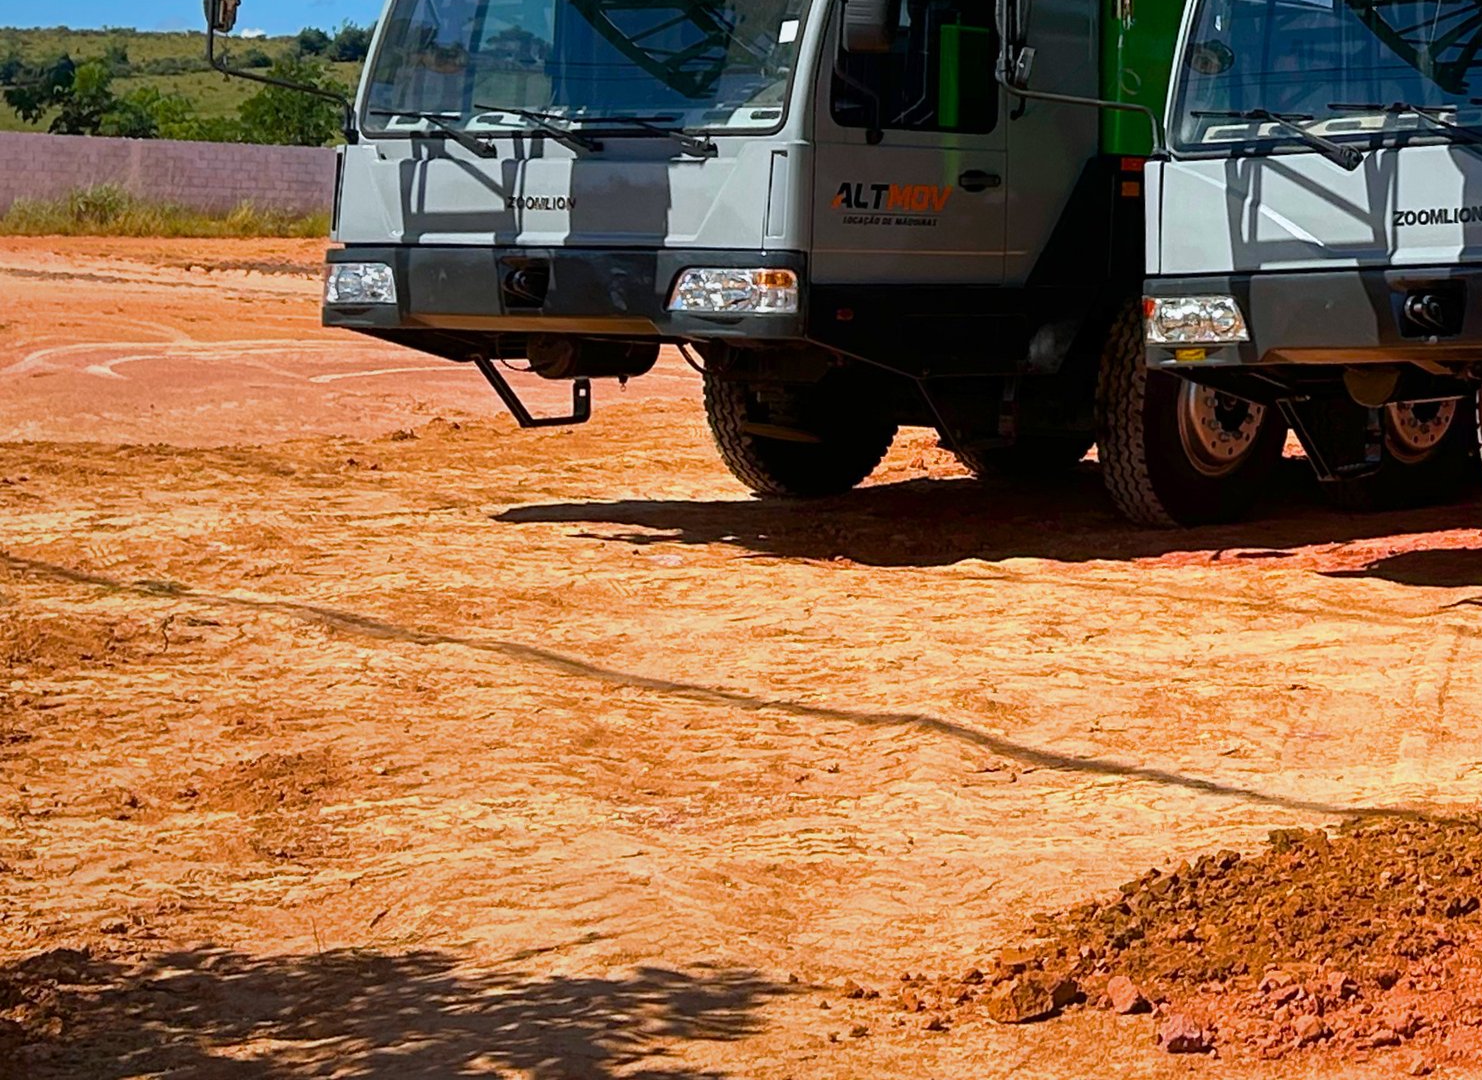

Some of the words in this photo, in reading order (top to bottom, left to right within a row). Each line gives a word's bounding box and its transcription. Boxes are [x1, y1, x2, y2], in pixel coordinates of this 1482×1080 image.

[507, 196, 577, 210] ZOOMLION
[831, 182, 954, 212] ALTMOV
[843, 215, 880, 226] LOCAÇÃO
[881, 217, 892, 225] DE
